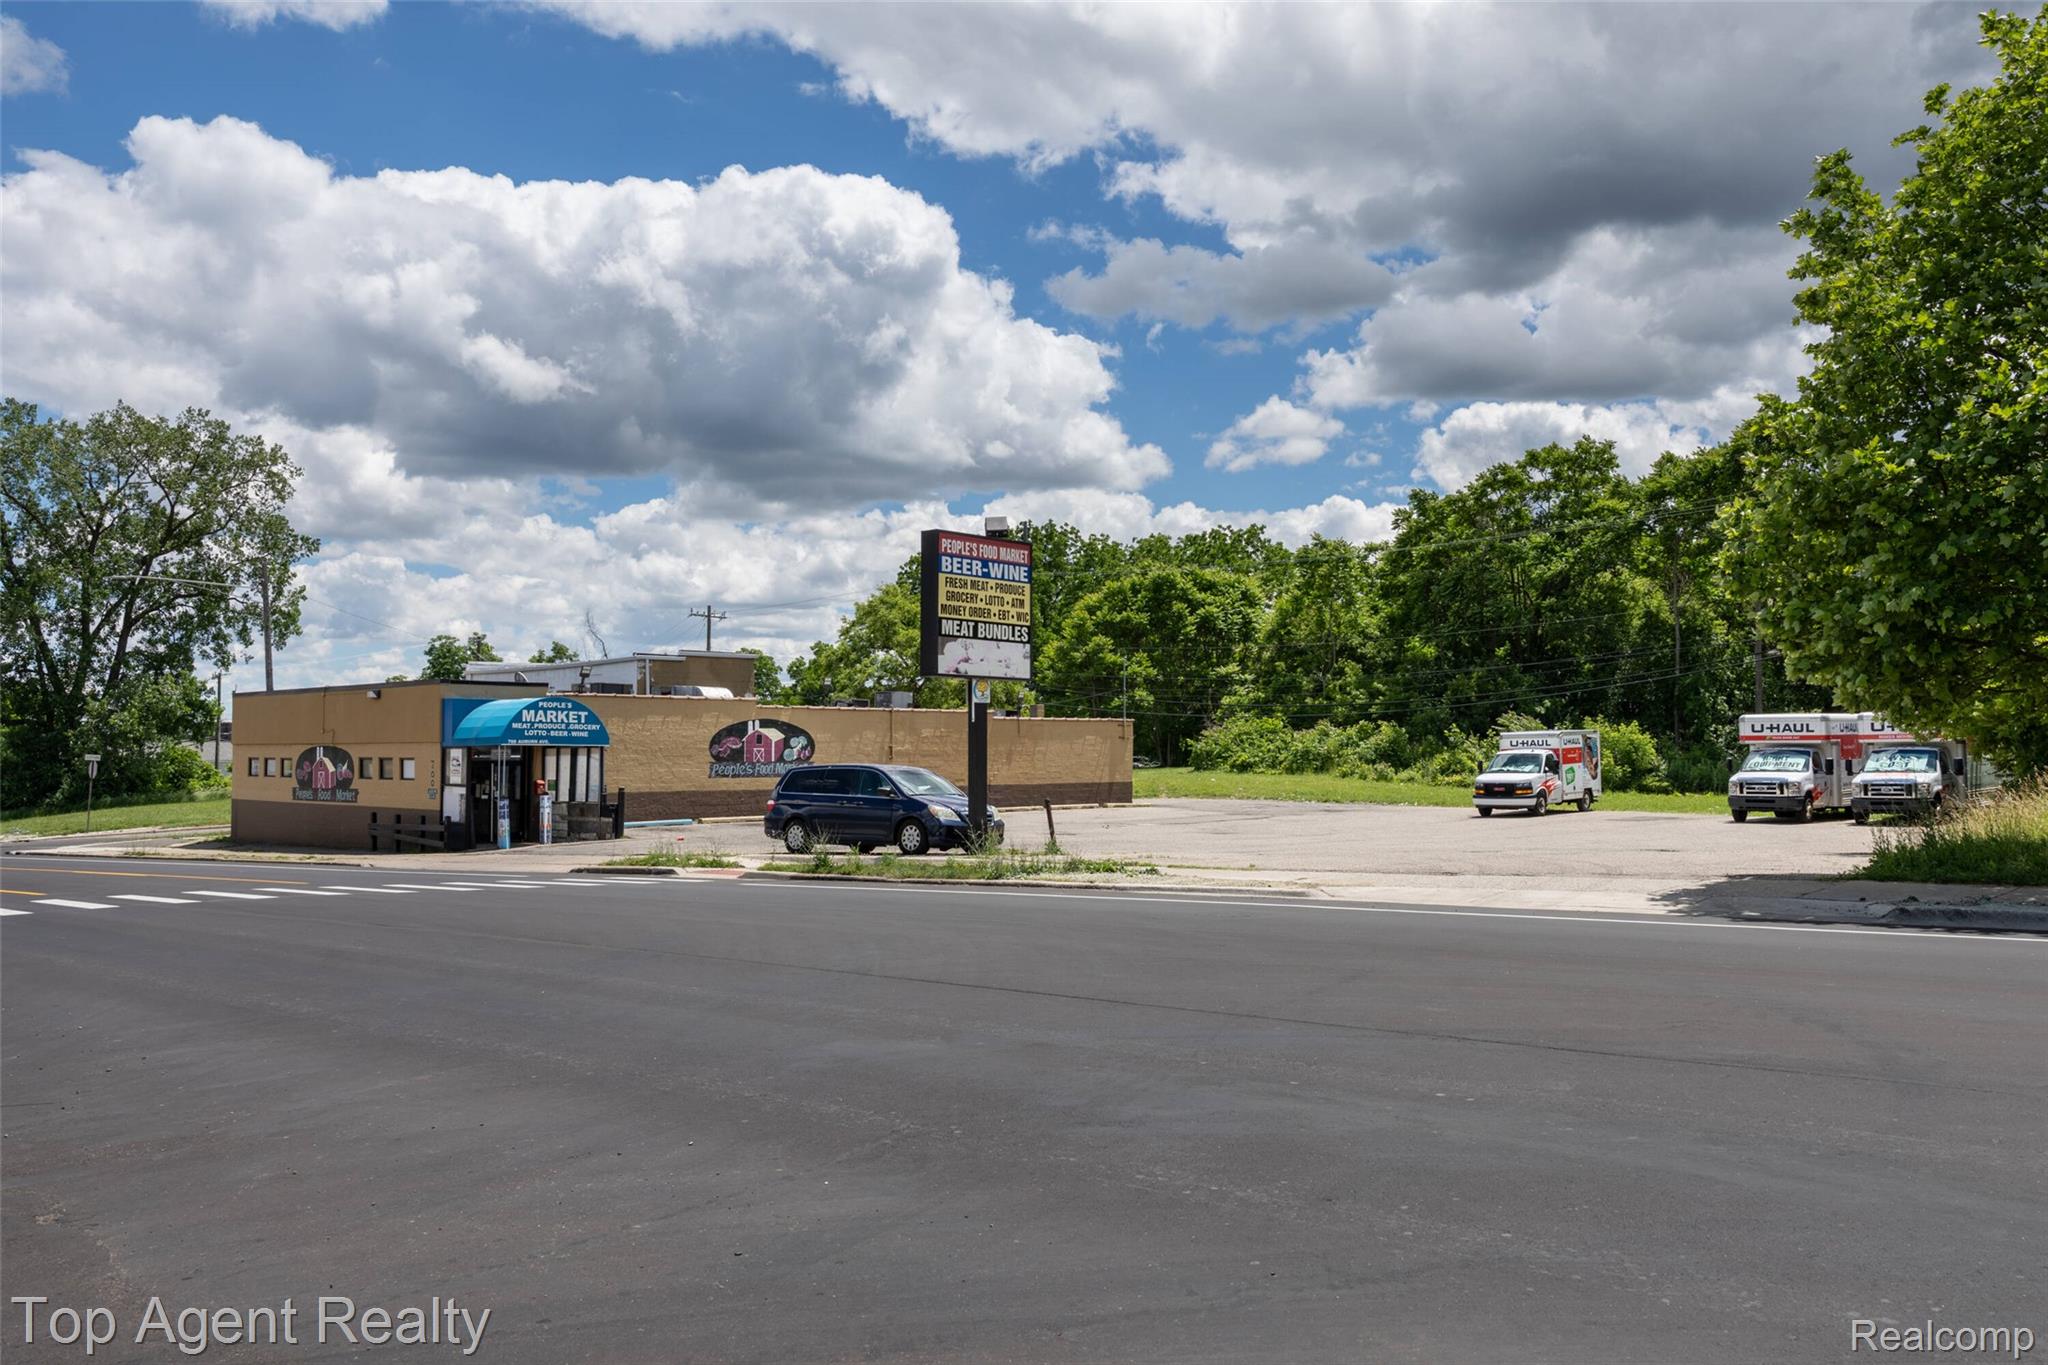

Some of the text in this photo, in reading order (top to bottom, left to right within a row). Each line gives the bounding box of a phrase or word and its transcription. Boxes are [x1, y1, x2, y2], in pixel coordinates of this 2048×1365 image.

[942, 538, 1029, 563] PEOPLE'S FOOD MARKET
[941, 555, 1028, 582] BEER-WINE
[945, 577, 1025, 596] FRESH MEAT PRODUCE
[945, 590, 1025, 609] GROCERY LOTTO ATM
[941, 603, 1029, 623] MONEY ORDER EBT WIC
[941, 619, 1029, 642] MEAT BUNDLES
[538, 701, 572, 709] PEOPLE'S
[522, 710, 588, 723] MARKET
[1750, 723, 1815, 733] U-HAUL
[1509, 739, 1551, 748] U-HAUL
[755, 762, 774, 776] Food
